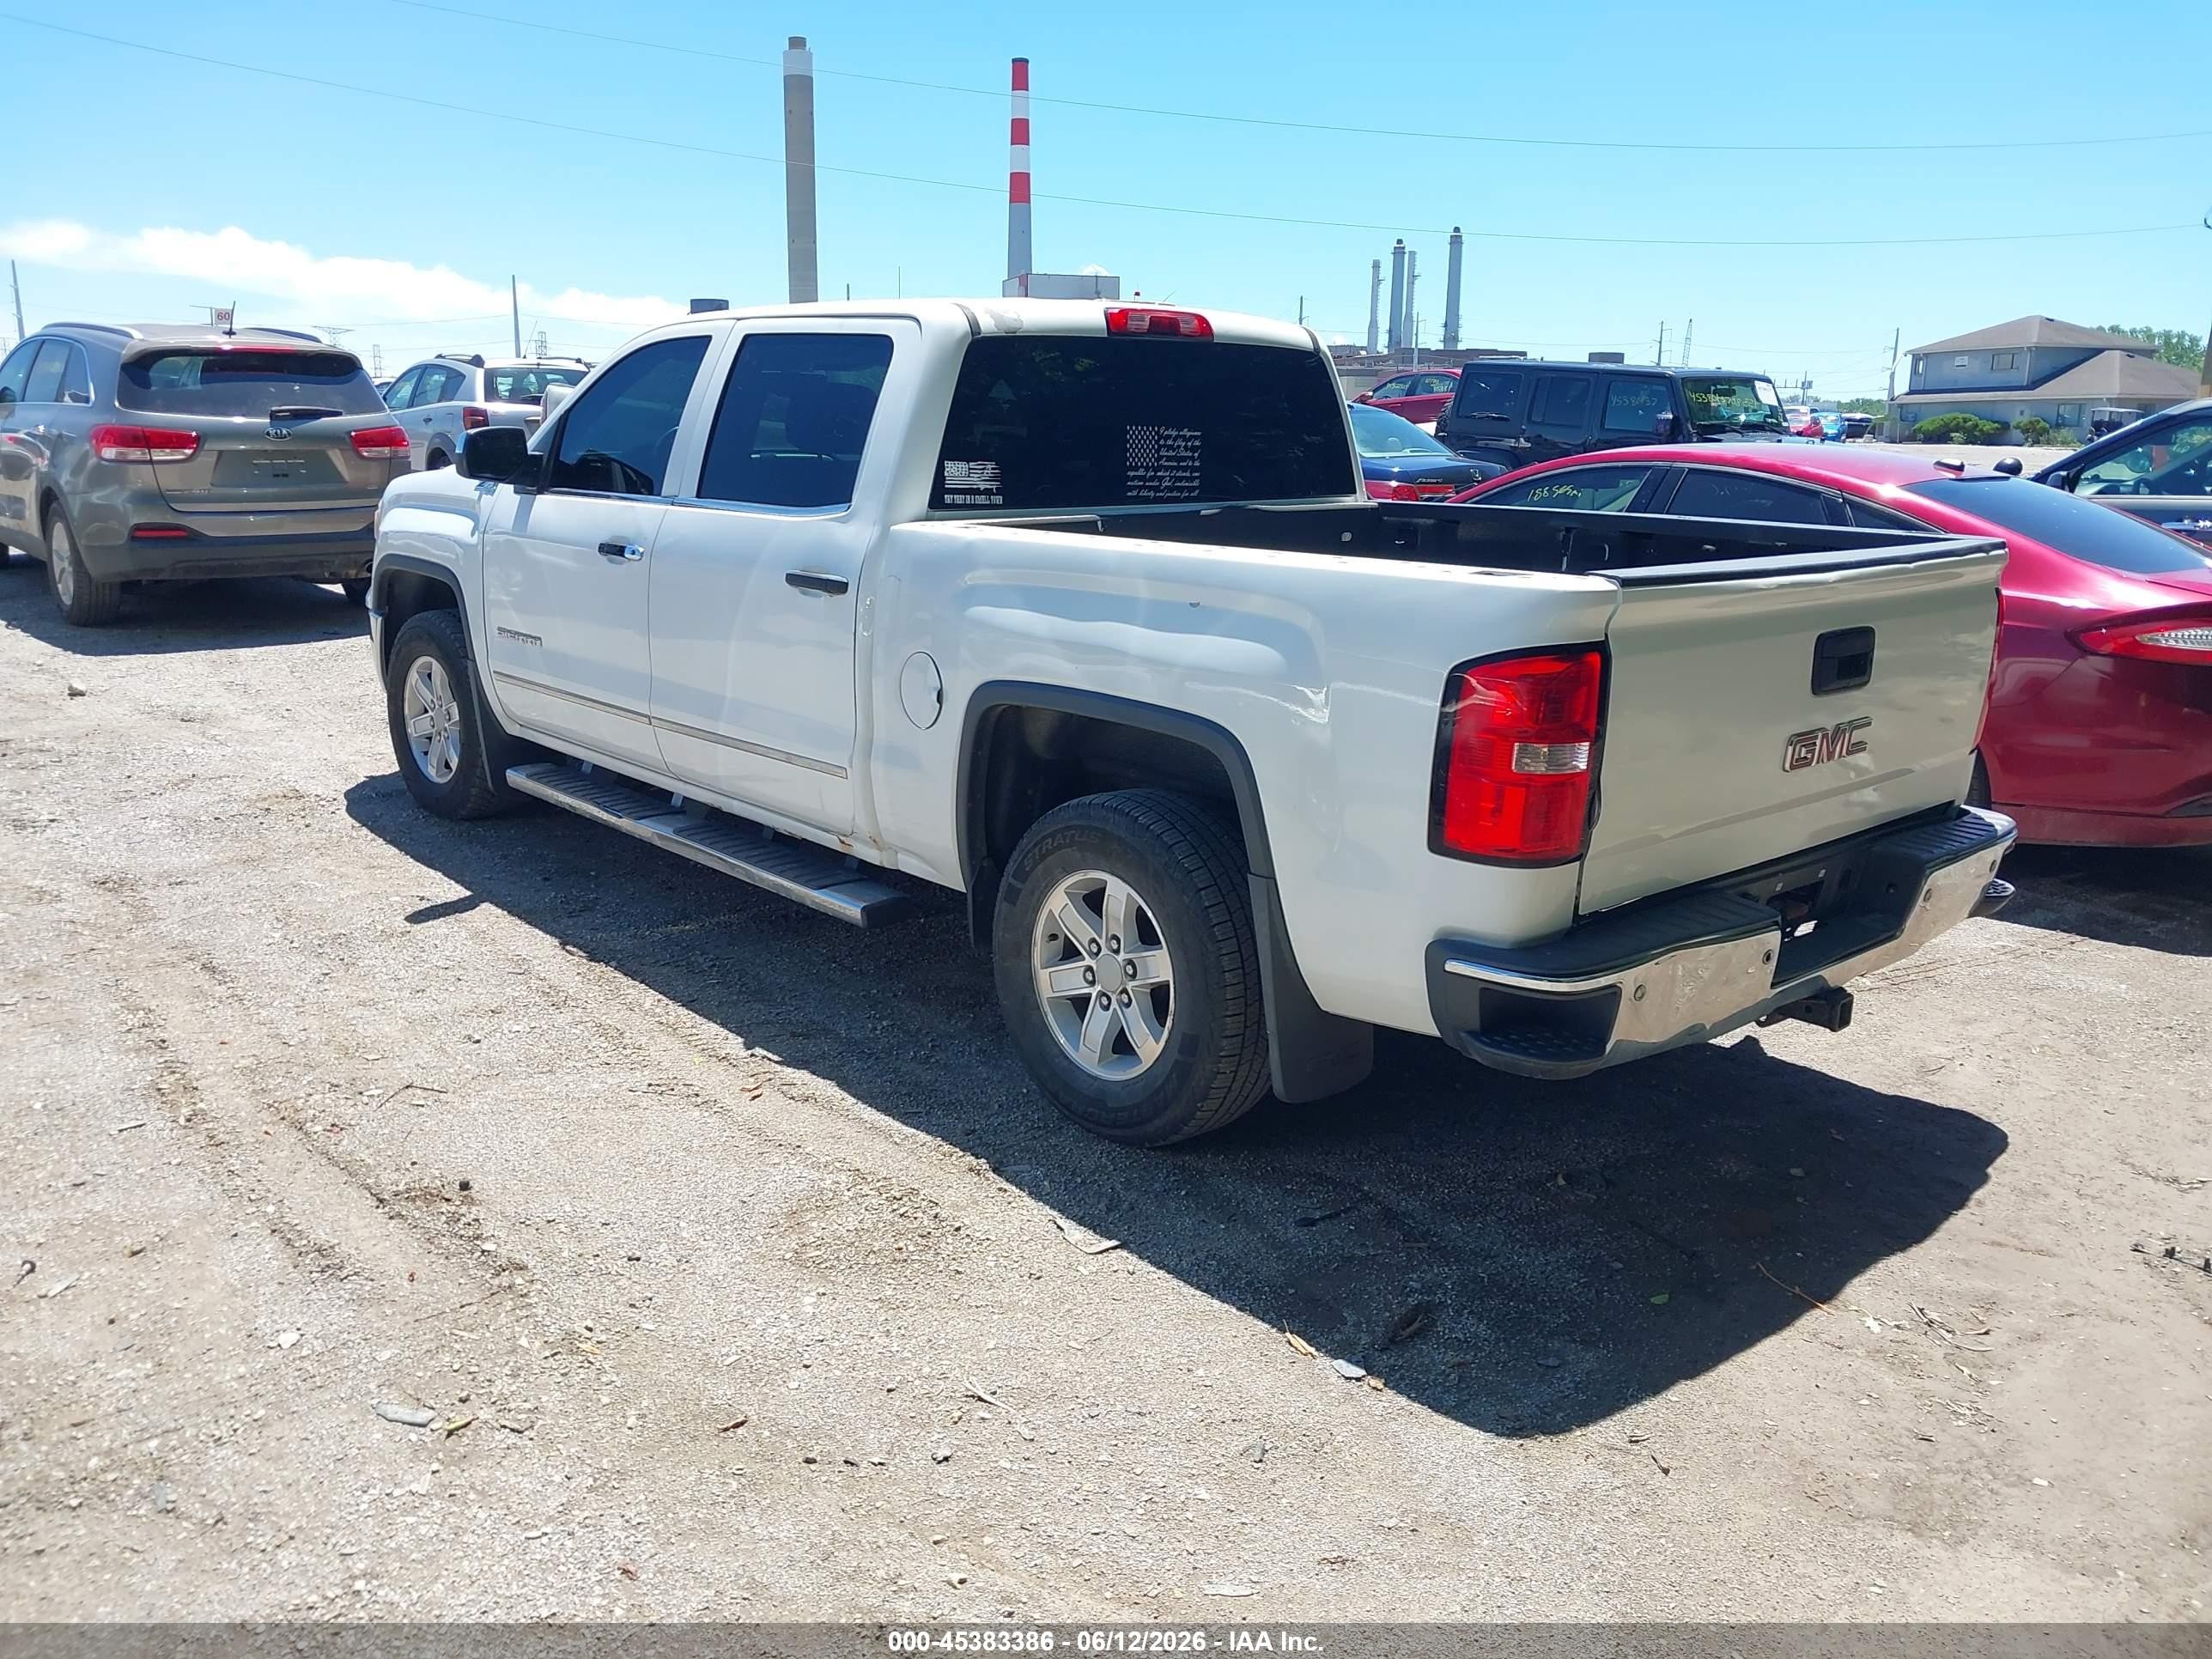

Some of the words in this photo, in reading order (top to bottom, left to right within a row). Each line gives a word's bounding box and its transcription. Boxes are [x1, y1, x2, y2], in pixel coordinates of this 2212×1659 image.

[217, 312, 230, 321] 60
[269, 429, 290, 439] KIA
[1783, 715, 1873, 773] GMC
[1024, 830, 1103, 871] STRATUS
